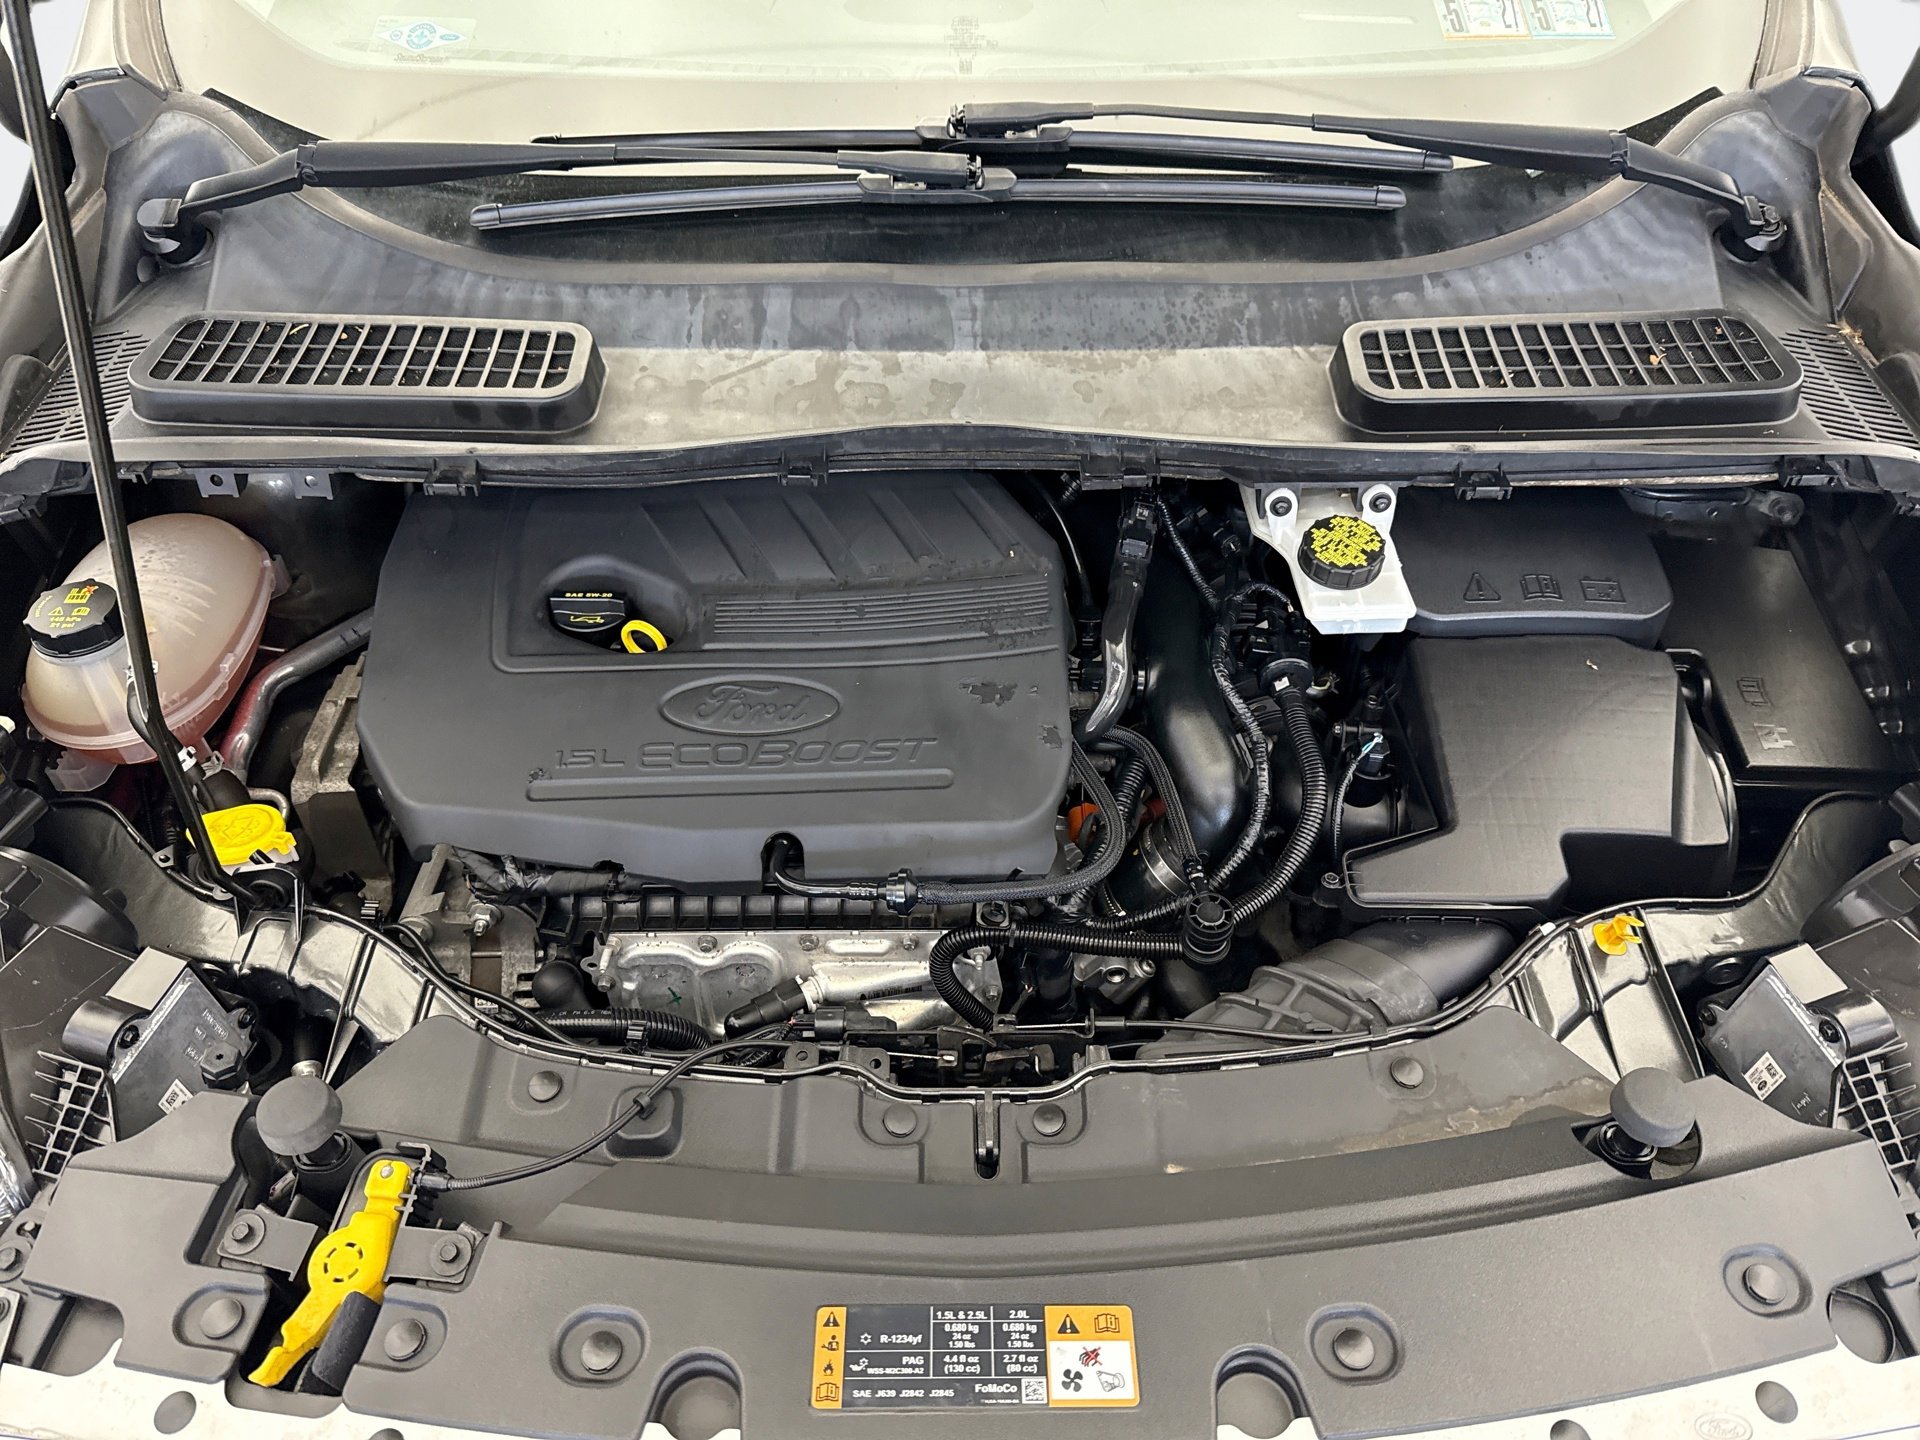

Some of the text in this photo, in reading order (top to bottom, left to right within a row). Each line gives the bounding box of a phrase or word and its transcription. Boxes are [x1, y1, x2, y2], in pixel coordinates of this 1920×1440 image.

[694, 684, 812, 725] Ford
[936, 1311, 956, 1319] 1.5L
[967, 1311, 987, 1319] 2.5L
[1009, 1310, 1030, 1319] 2.0L
[944, 1323, 979, 1333] 0.680 kg
[1002, 1323, 1037, 1333] 0.680 kg
[880, 1334, 922, 1345] R-1234yf
[902, 1356, 924, 1365] PAG
[944, 1355, 957, 1363] 4.4
[959, 1355, 966, 1363] fl
[1003, 1354, 1016, 1362] 2.7
[1018, 1354, 1025, 1362] fl
[944, 1364, 981, 1374] (130 cc)
[1006, 1364, 1037, 1374] (80 cc)
[929, 1389, 954, 1397] J2845
[974, 1384, 1018, 1393] FoMoCo
